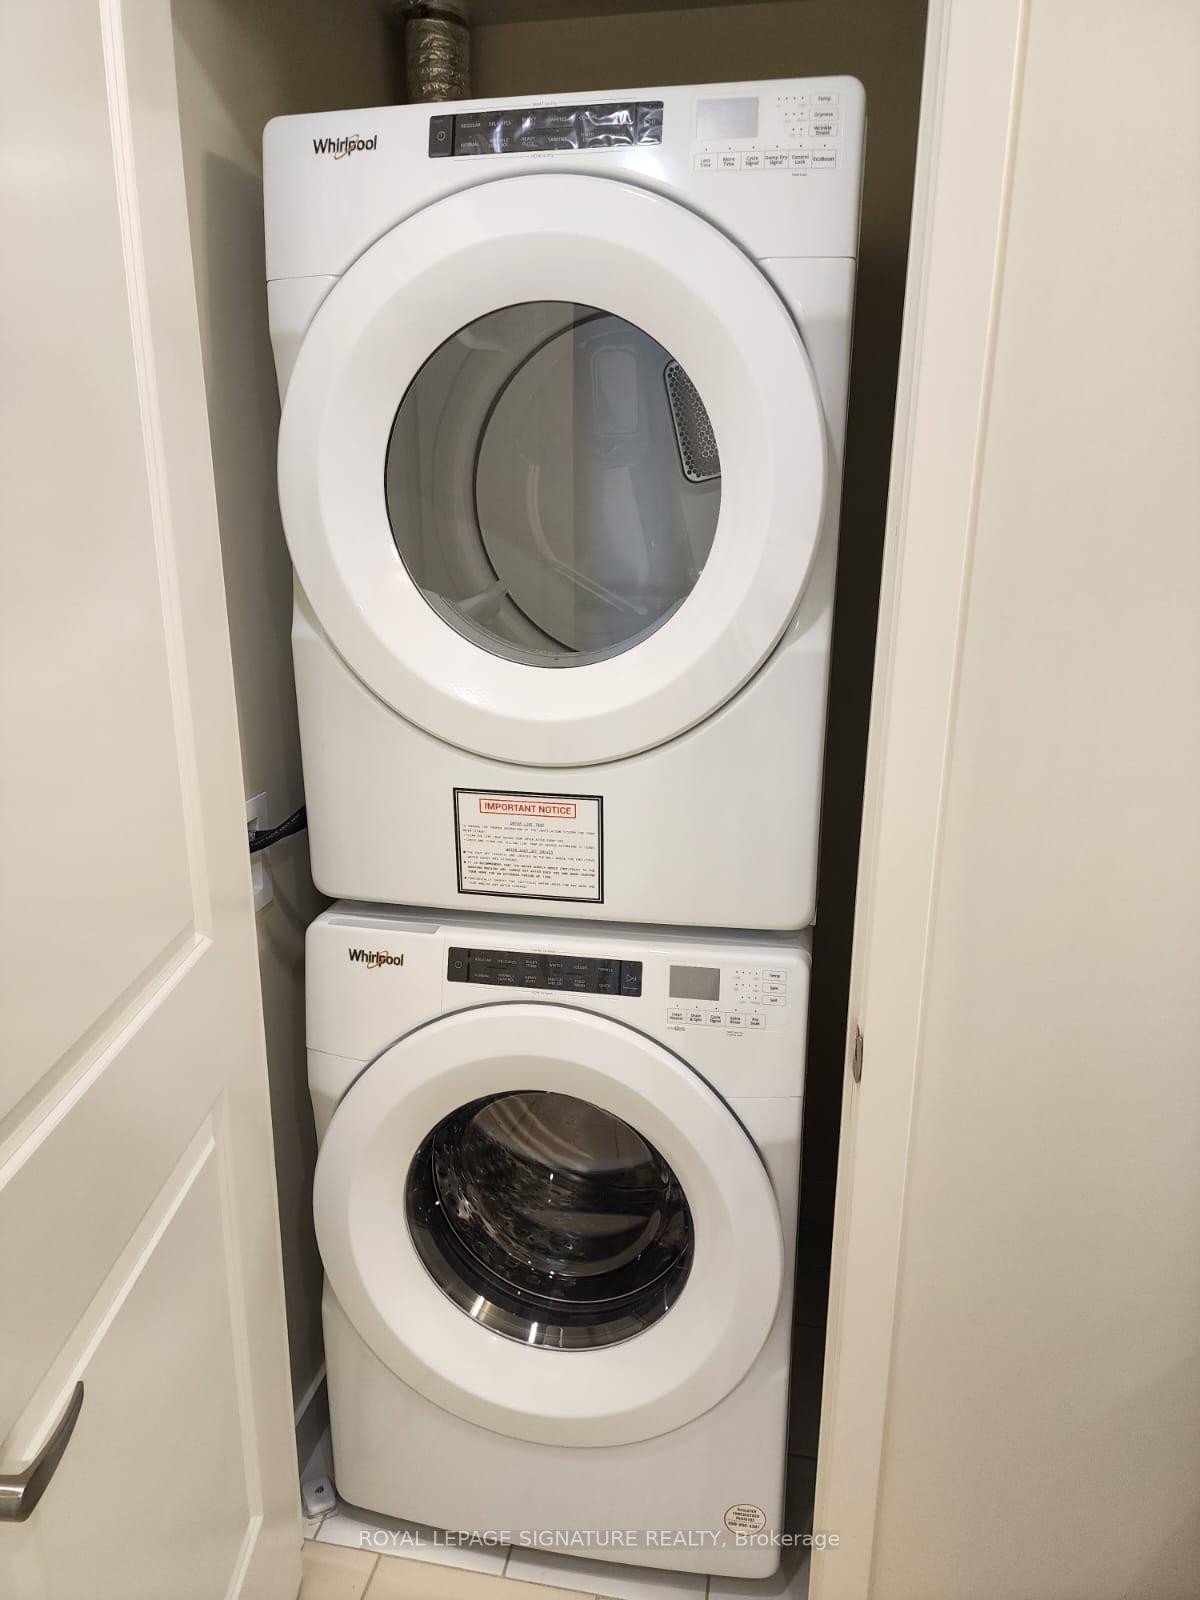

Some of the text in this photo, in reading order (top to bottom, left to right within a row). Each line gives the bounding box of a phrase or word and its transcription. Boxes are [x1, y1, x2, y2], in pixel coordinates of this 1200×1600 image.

[312, 133, 378, 157] Whirlpool
[484, 802, 572, 815] IMPORTANT NOTICE
[348, 948, 404, 968] Whirlpool
